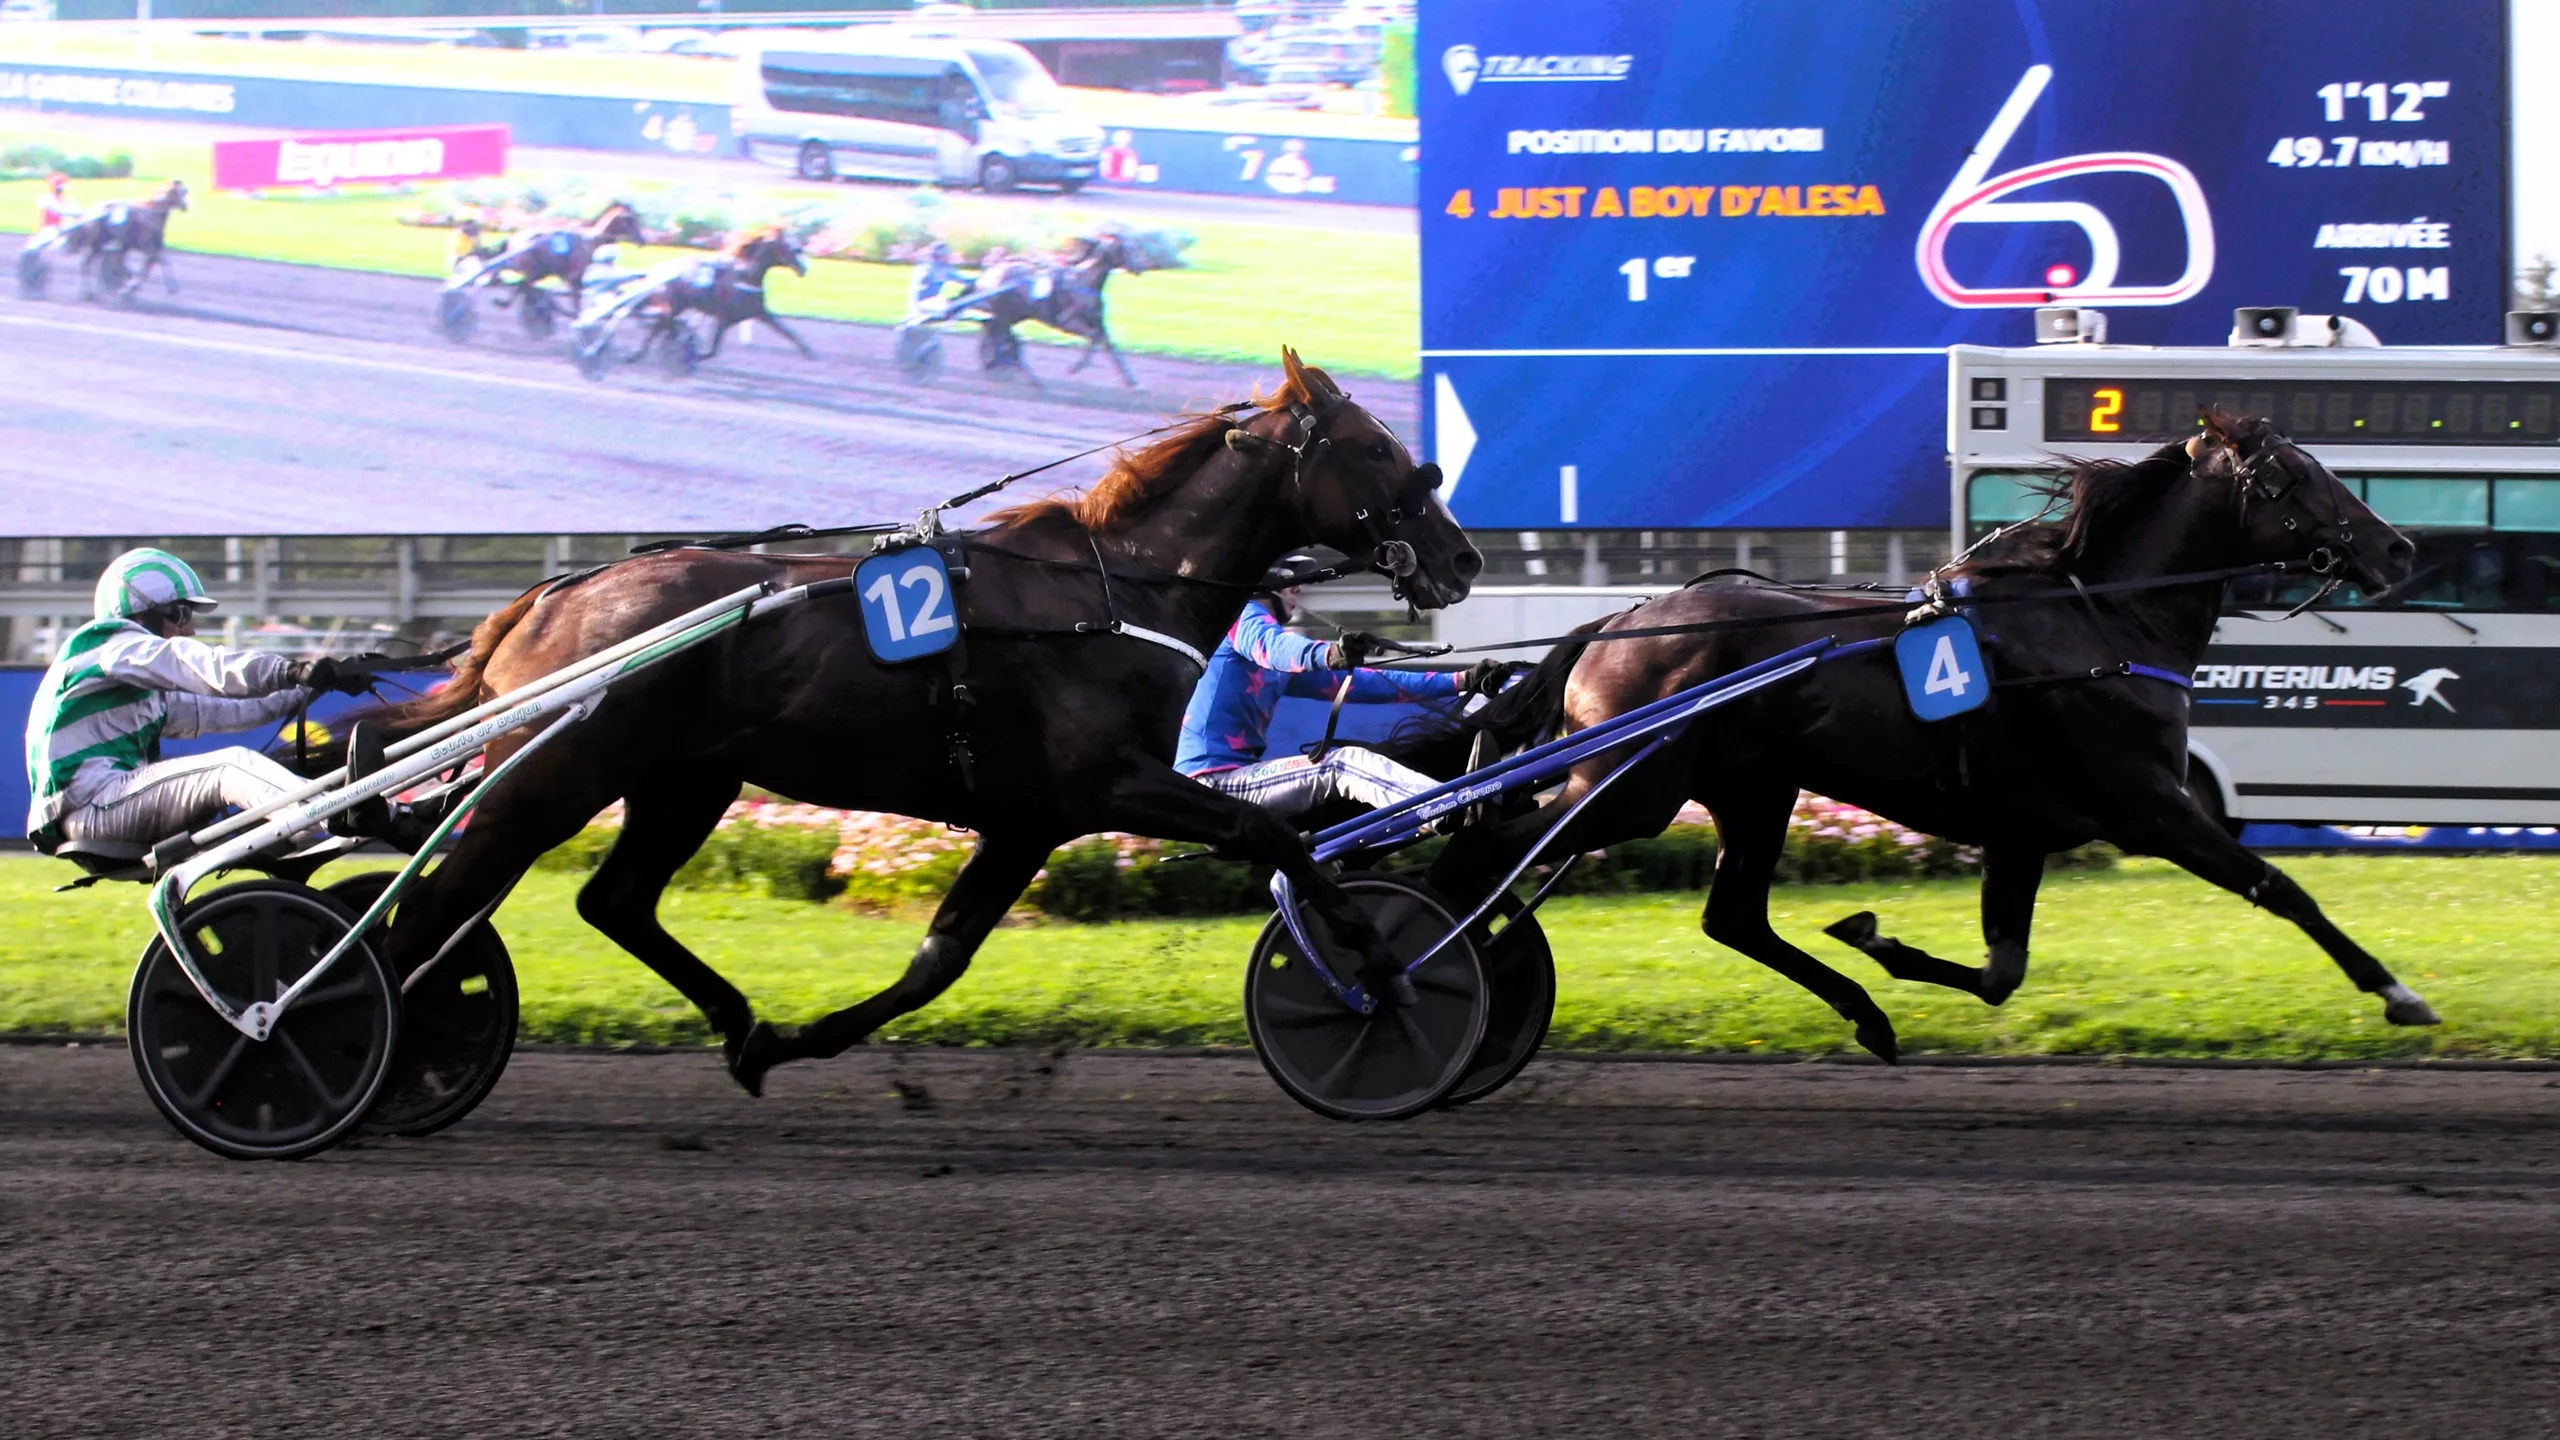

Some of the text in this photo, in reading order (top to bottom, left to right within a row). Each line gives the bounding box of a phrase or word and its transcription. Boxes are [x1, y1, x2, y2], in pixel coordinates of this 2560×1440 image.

[1481, 54, 1634, 76] TRACKING
[1507, 128, 1824, 154] POSITION DU FAVORI
[2267, 136, 2359, 167] 49.7
[1445, 185, 1886, 219] 4 JUST A BOY D'ALESA
[2314, 216, 2451, 248] ARRIVÉE
[2339, 266, 2449, 304] 70 M
[2090, 389, 2123, 432] 2
[864, 565, 954, 642] 12
[1924, 635, 1970, 697] 4
[2191, 664, 2397, 690] CRITERIUMS
[1457, 781, 1502, 804] Chrono
